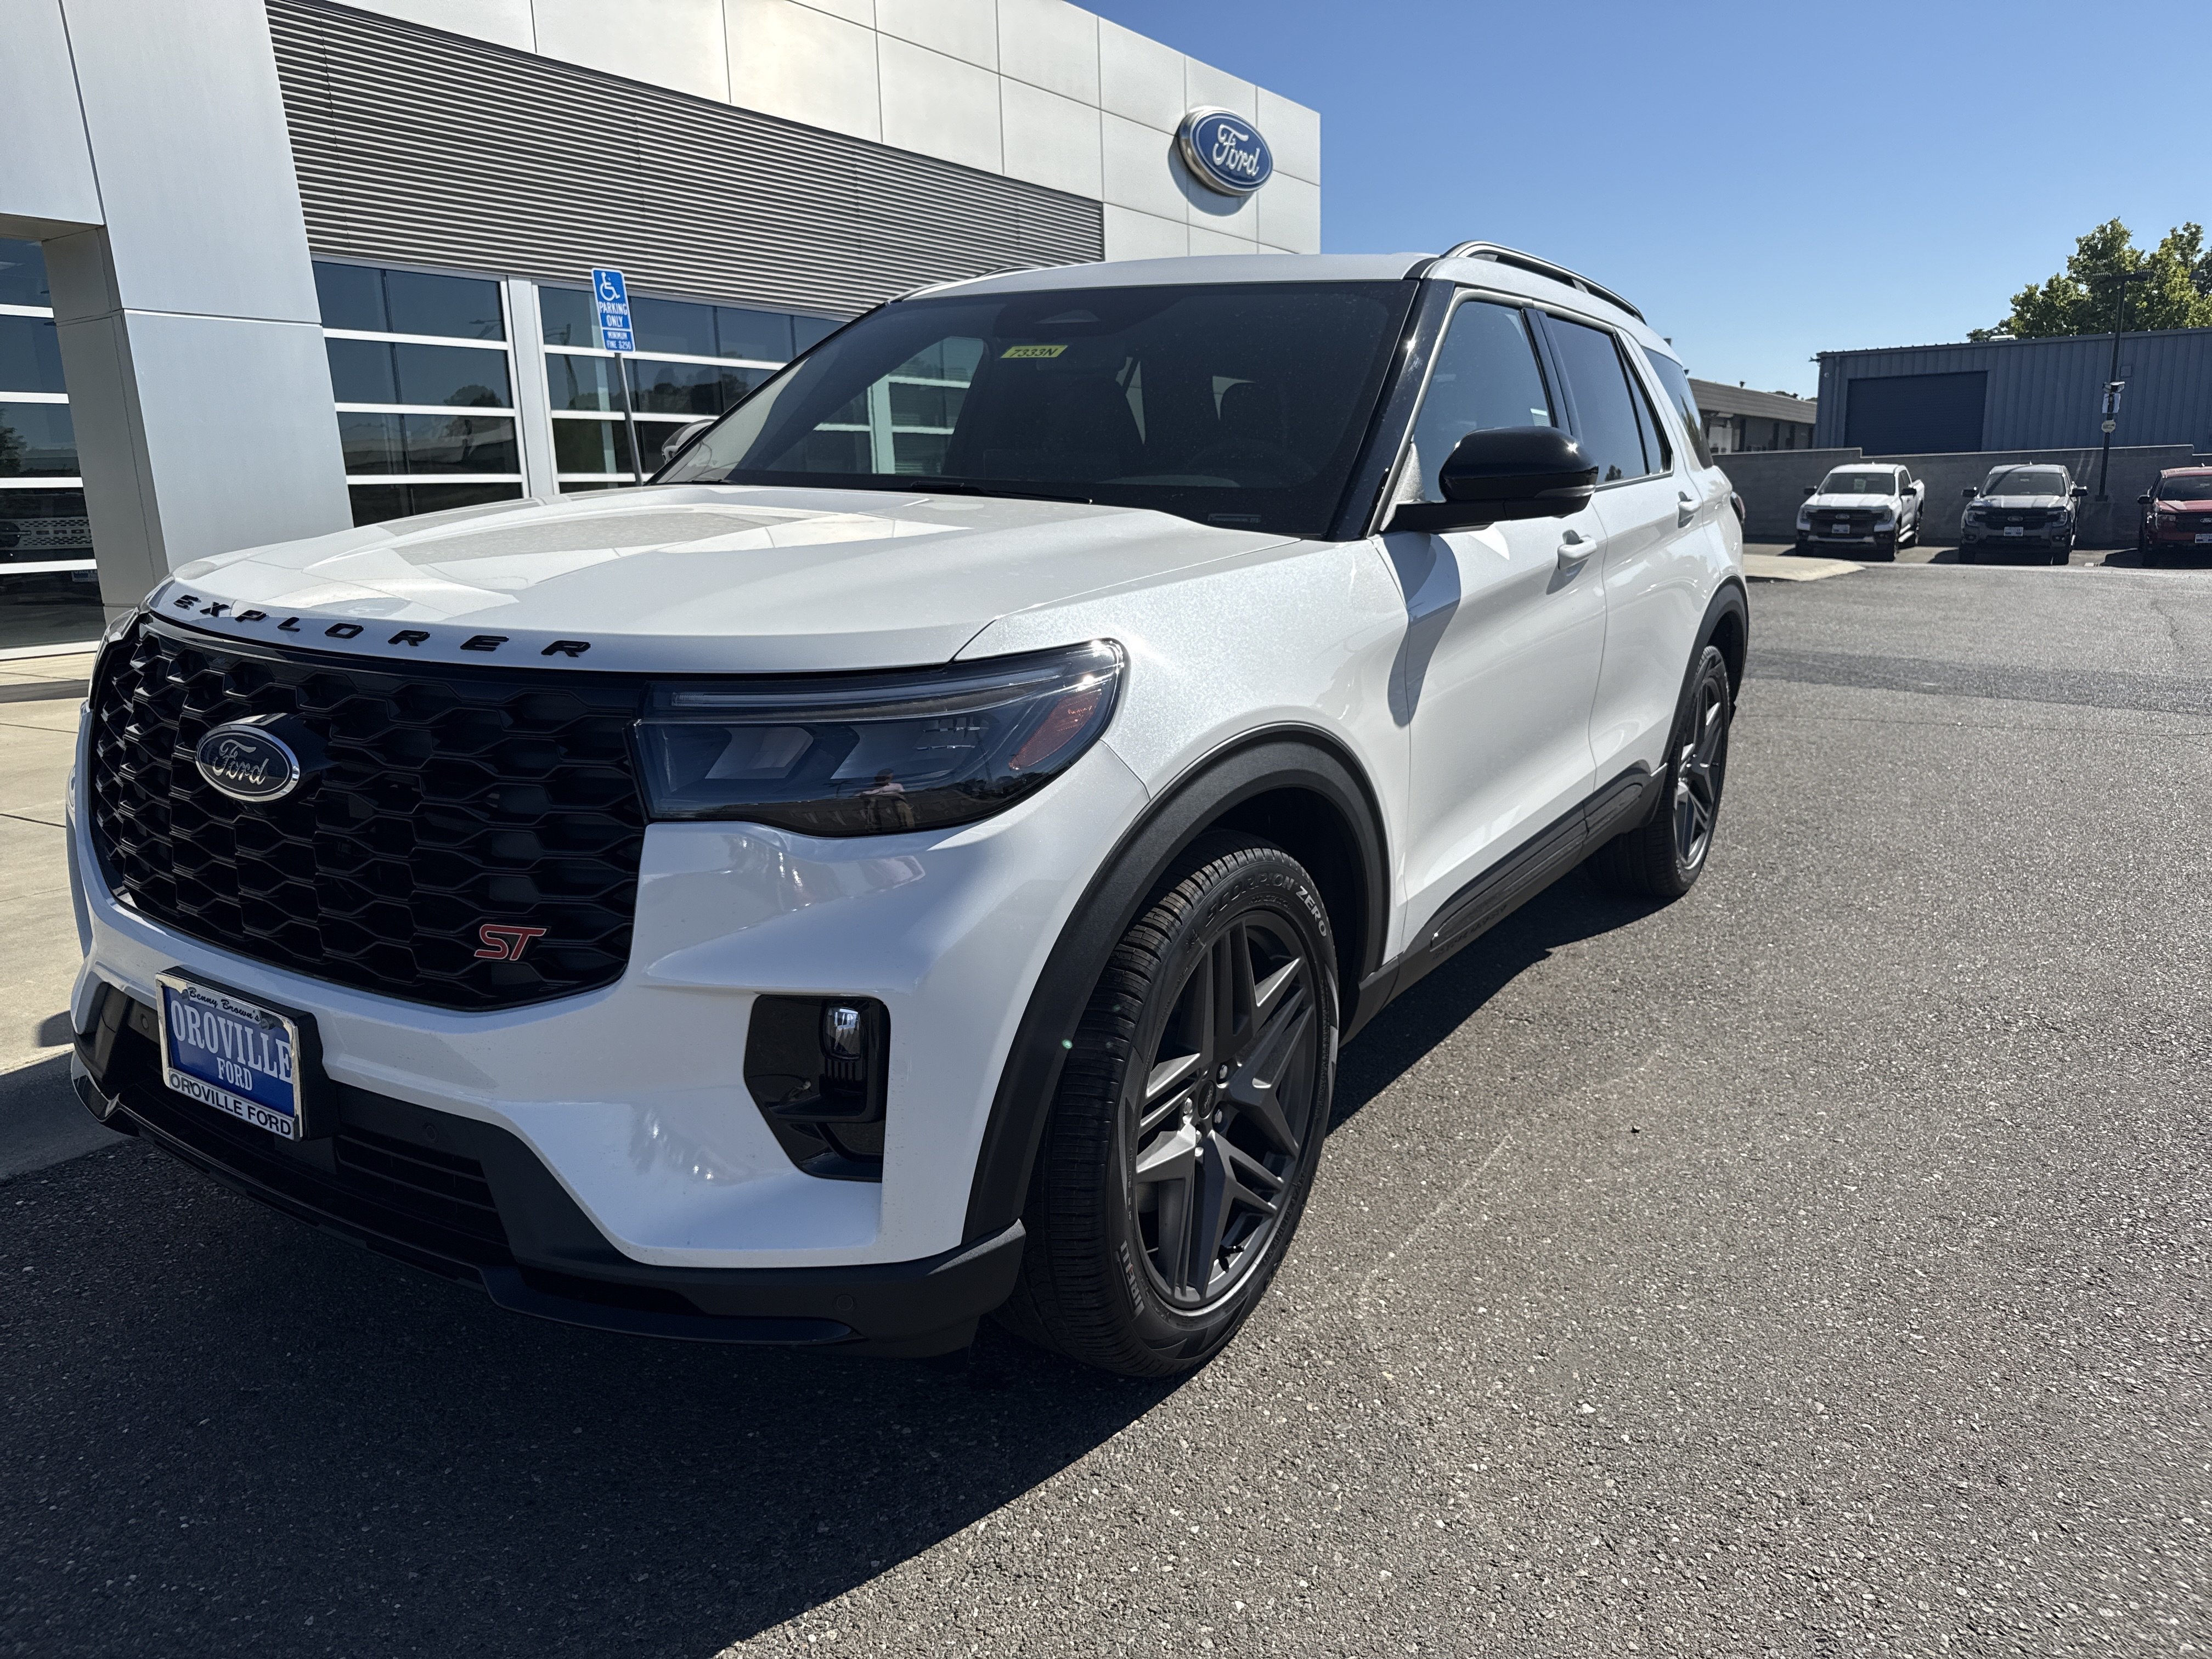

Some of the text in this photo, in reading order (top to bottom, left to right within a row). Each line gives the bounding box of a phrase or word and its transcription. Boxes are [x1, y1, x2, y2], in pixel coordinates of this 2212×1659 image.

[1213, 124, 1260, 176] Ford
[599, 302, 628, 315] PARKING
[607, 315, 623, 328] ONLY
[1009, 348, 1058, 357] 7333N
[172, 594, 591, 657] EXPLORER
[212, 739, 269, 785] Ford
[1296, 885, 1327, 936] ZERO
[474, 924, 547, 961] ST
[189, 987, 261, 1022] Benny Brown's
[171, 1000, 293, 1084] OROVILLE
[217, 1057, 253, 1091] FORD
[170, 1074, 291, 1135] OROVILLE FORD
